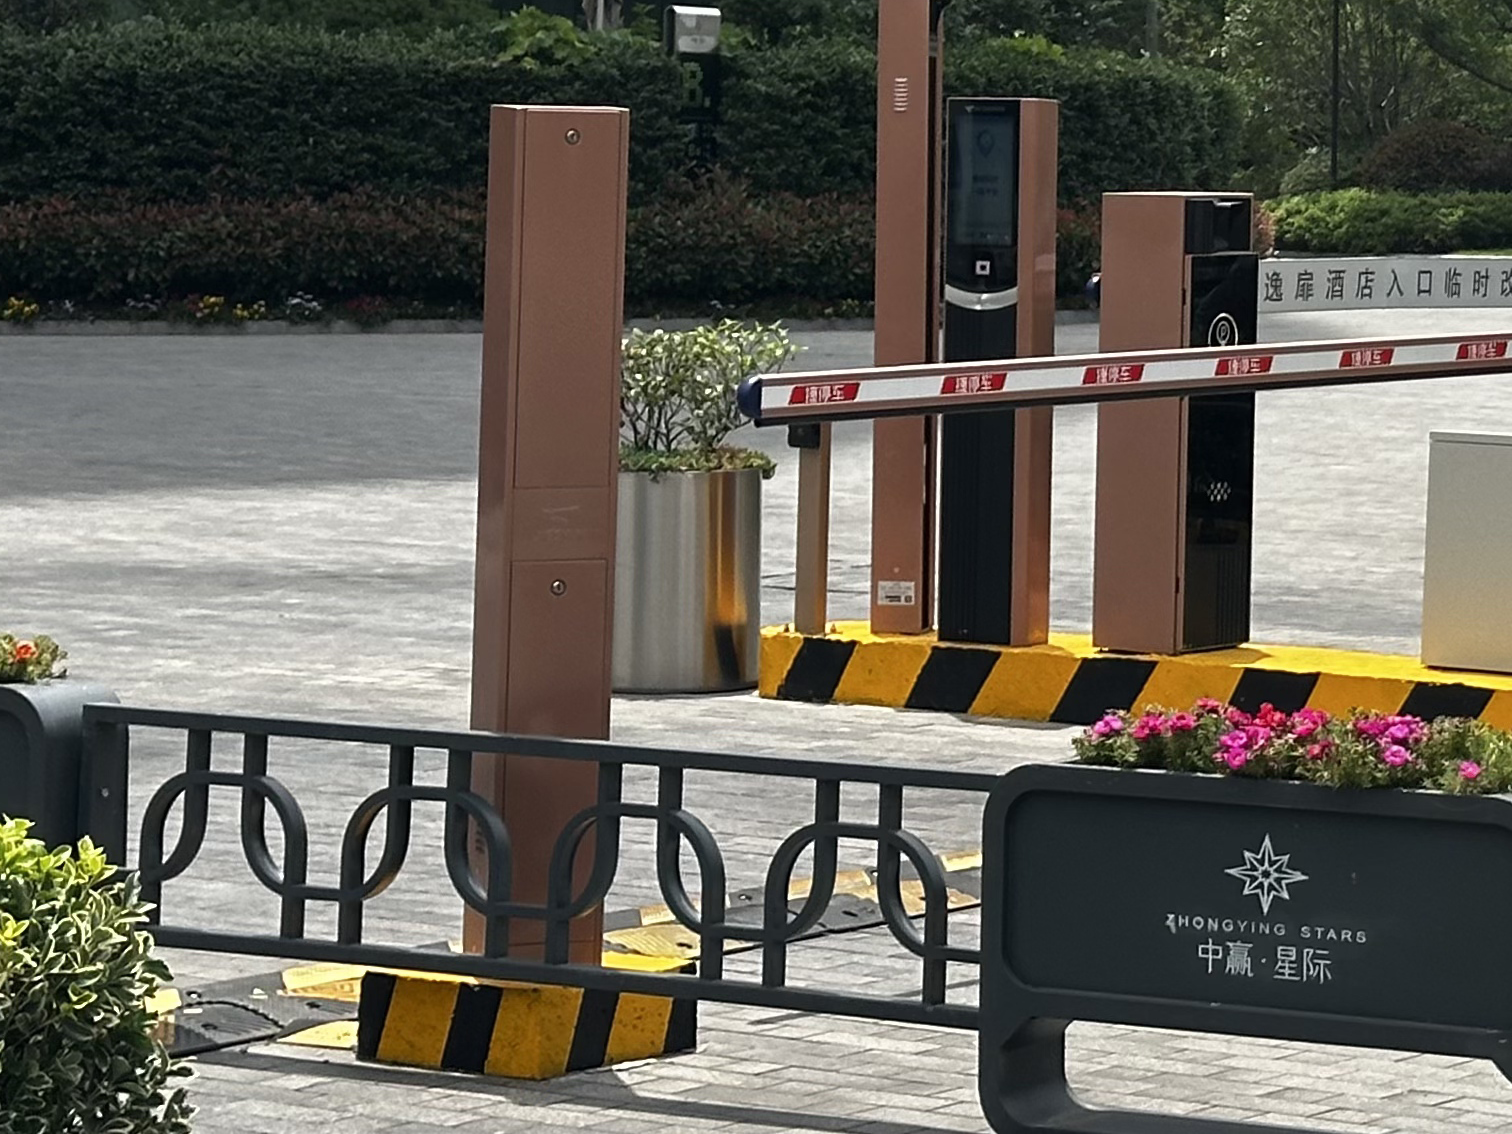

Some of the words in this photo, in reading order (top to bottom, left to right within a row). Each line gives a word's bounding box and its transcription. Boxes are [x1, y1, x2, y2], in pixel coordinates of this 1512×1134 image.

[1300, 925, 1367, 944] STARS
[1198, 938, 1332, 985] 中赢·星际
